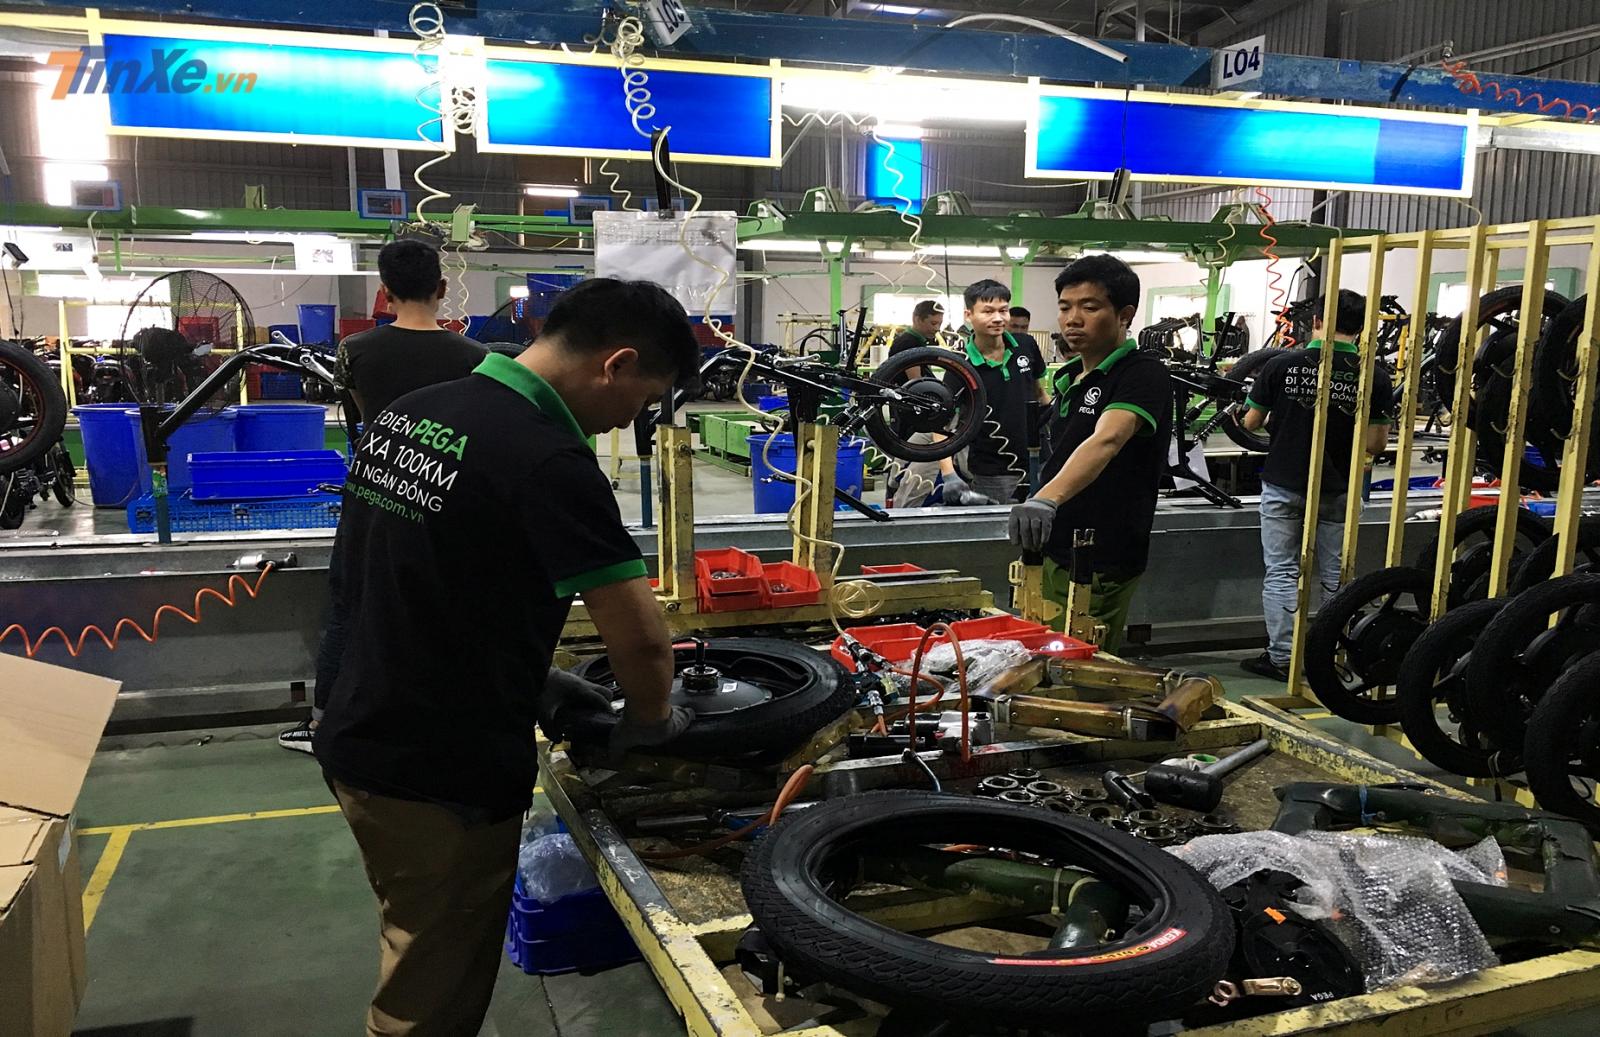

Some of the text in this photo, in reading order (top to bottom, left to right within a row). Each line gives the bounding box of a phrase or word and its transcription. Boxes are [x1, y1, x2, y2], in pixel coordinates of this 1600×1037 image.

[1287, 366, 1299, 374] XE
[1285, 376, 1297, 385] ĐI
[1078, 406, 1095, 415] PEGA
[409, 418, 469, 462] PEGA
[361, 432, 459, 491] XA 100KM
[1147, 928, 1183, 949] KENDA
[1310, 991, 1335, 1001] PEGA
